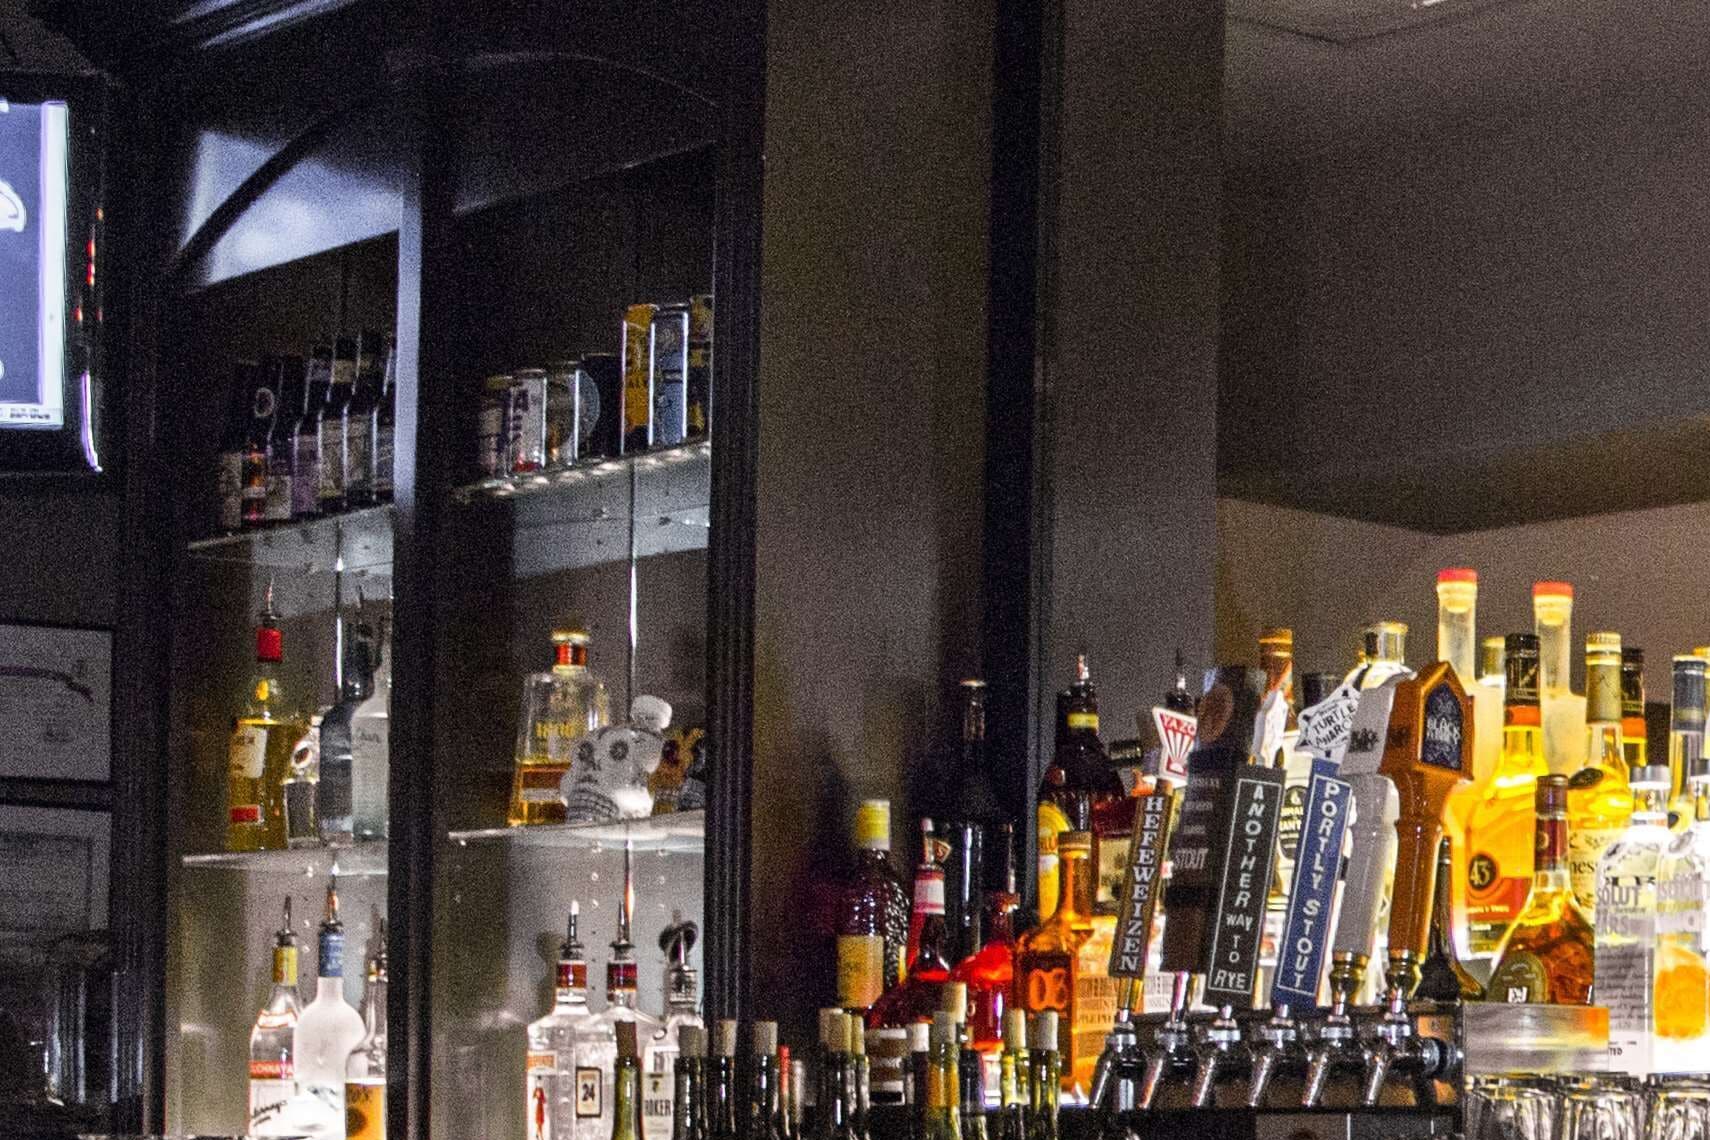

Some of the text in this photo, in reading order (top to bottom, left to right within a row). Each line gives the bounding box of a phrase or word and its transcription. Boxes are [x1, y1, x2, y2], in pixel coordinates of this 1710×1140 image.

[1313, 703, 1356, 735] TURTLE
[1118, 796, 1163, 973] HEFEWEIZEN
[1292, 781, 1341, 989] PORTLY STOUT
[1470, 860, 1491, 888] 43
[1226, 912, 1252, 931] WAY
[1214, 969, 1247, 990] RYE
[582, 1083, 596, 1102] 24
